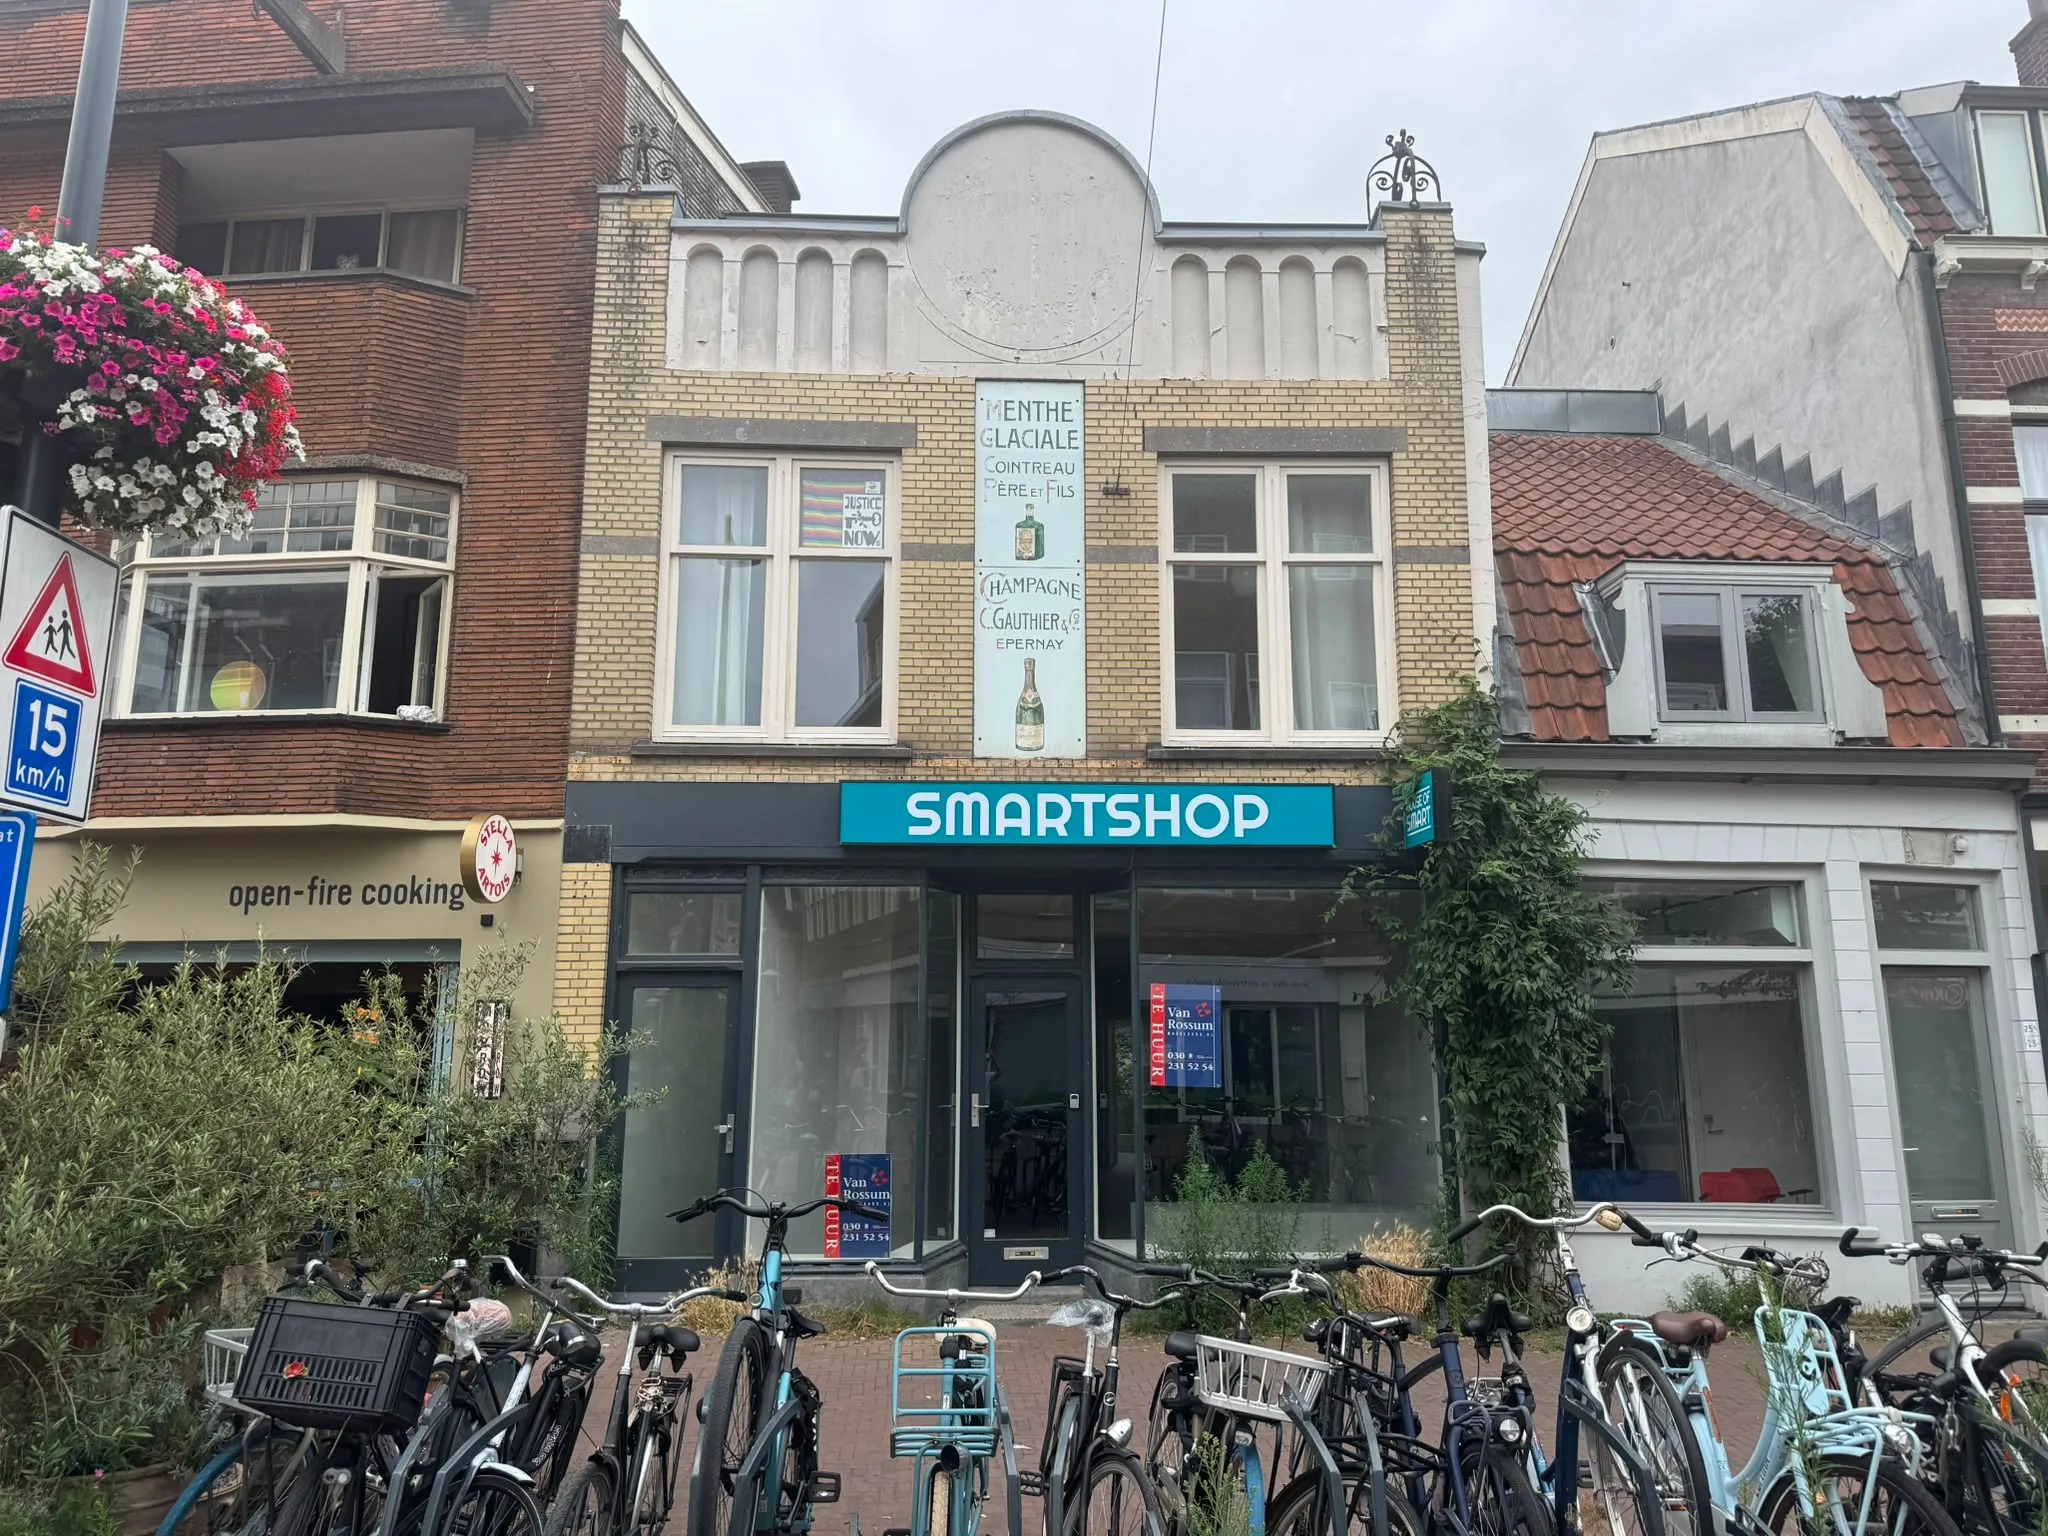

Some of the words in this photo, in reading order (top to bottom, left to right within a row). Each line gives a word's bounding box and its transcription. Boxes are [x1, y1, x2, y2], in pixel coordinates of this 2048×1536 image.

[986, 400, 1074, 422] MENTHE
[980, 428, 1079, 450] GLACIALE
[984, 455, 1075, 475] COINTREAU
[1031, 488, 1043, 498] ET
[1046, 479, 1075, 503] FILS
[844, 496, 882, 510] JUSTICE
[844, 530, 881, 546] NOW
[980, 572, 1081, 604] CHAMPAGNE
[996, 638, 1064, 650] EPERNAY
[29, 699, 68, 758] 15
[15, 757, 65, 793] km/h
[1422, 790, 1430, 805] OF
[906, 791, 1270, 838] SMARTSHOP
[1406, 805, 1431, 832] SMART
[481, 820, 513, 854] STELLA
[478, 867, 510, 896] ARTOIS
[228, 876, 352, 915] open-fire
[361, 874, 466, 911] cooking
[1152, 991, 1164, 1014] TE
[1168, 1006, 1191, 1018] Van
[1168, 1019, 1213, 1031] Rossum
[1151, 1023, 1164, 1077] HUUR
[1167, 1051, 1185, 1060] 030
[1167, 1062, 1185, 1070] 231
[1188, 1062, 1200, 1071] 52
[1202, 1063, 1214, 1071] 54
[827, 1161, 839, 1185] TE
[843, 1177, 867, 1188] Van
[843, 1189, 889, 1200] Rossum
[842, 1222, 861, 1231] 030
[842, 1233, 860, 1242] 231
[863, 1233, 875, 1241] 52
[877, 1233, 890, 1241] 54
